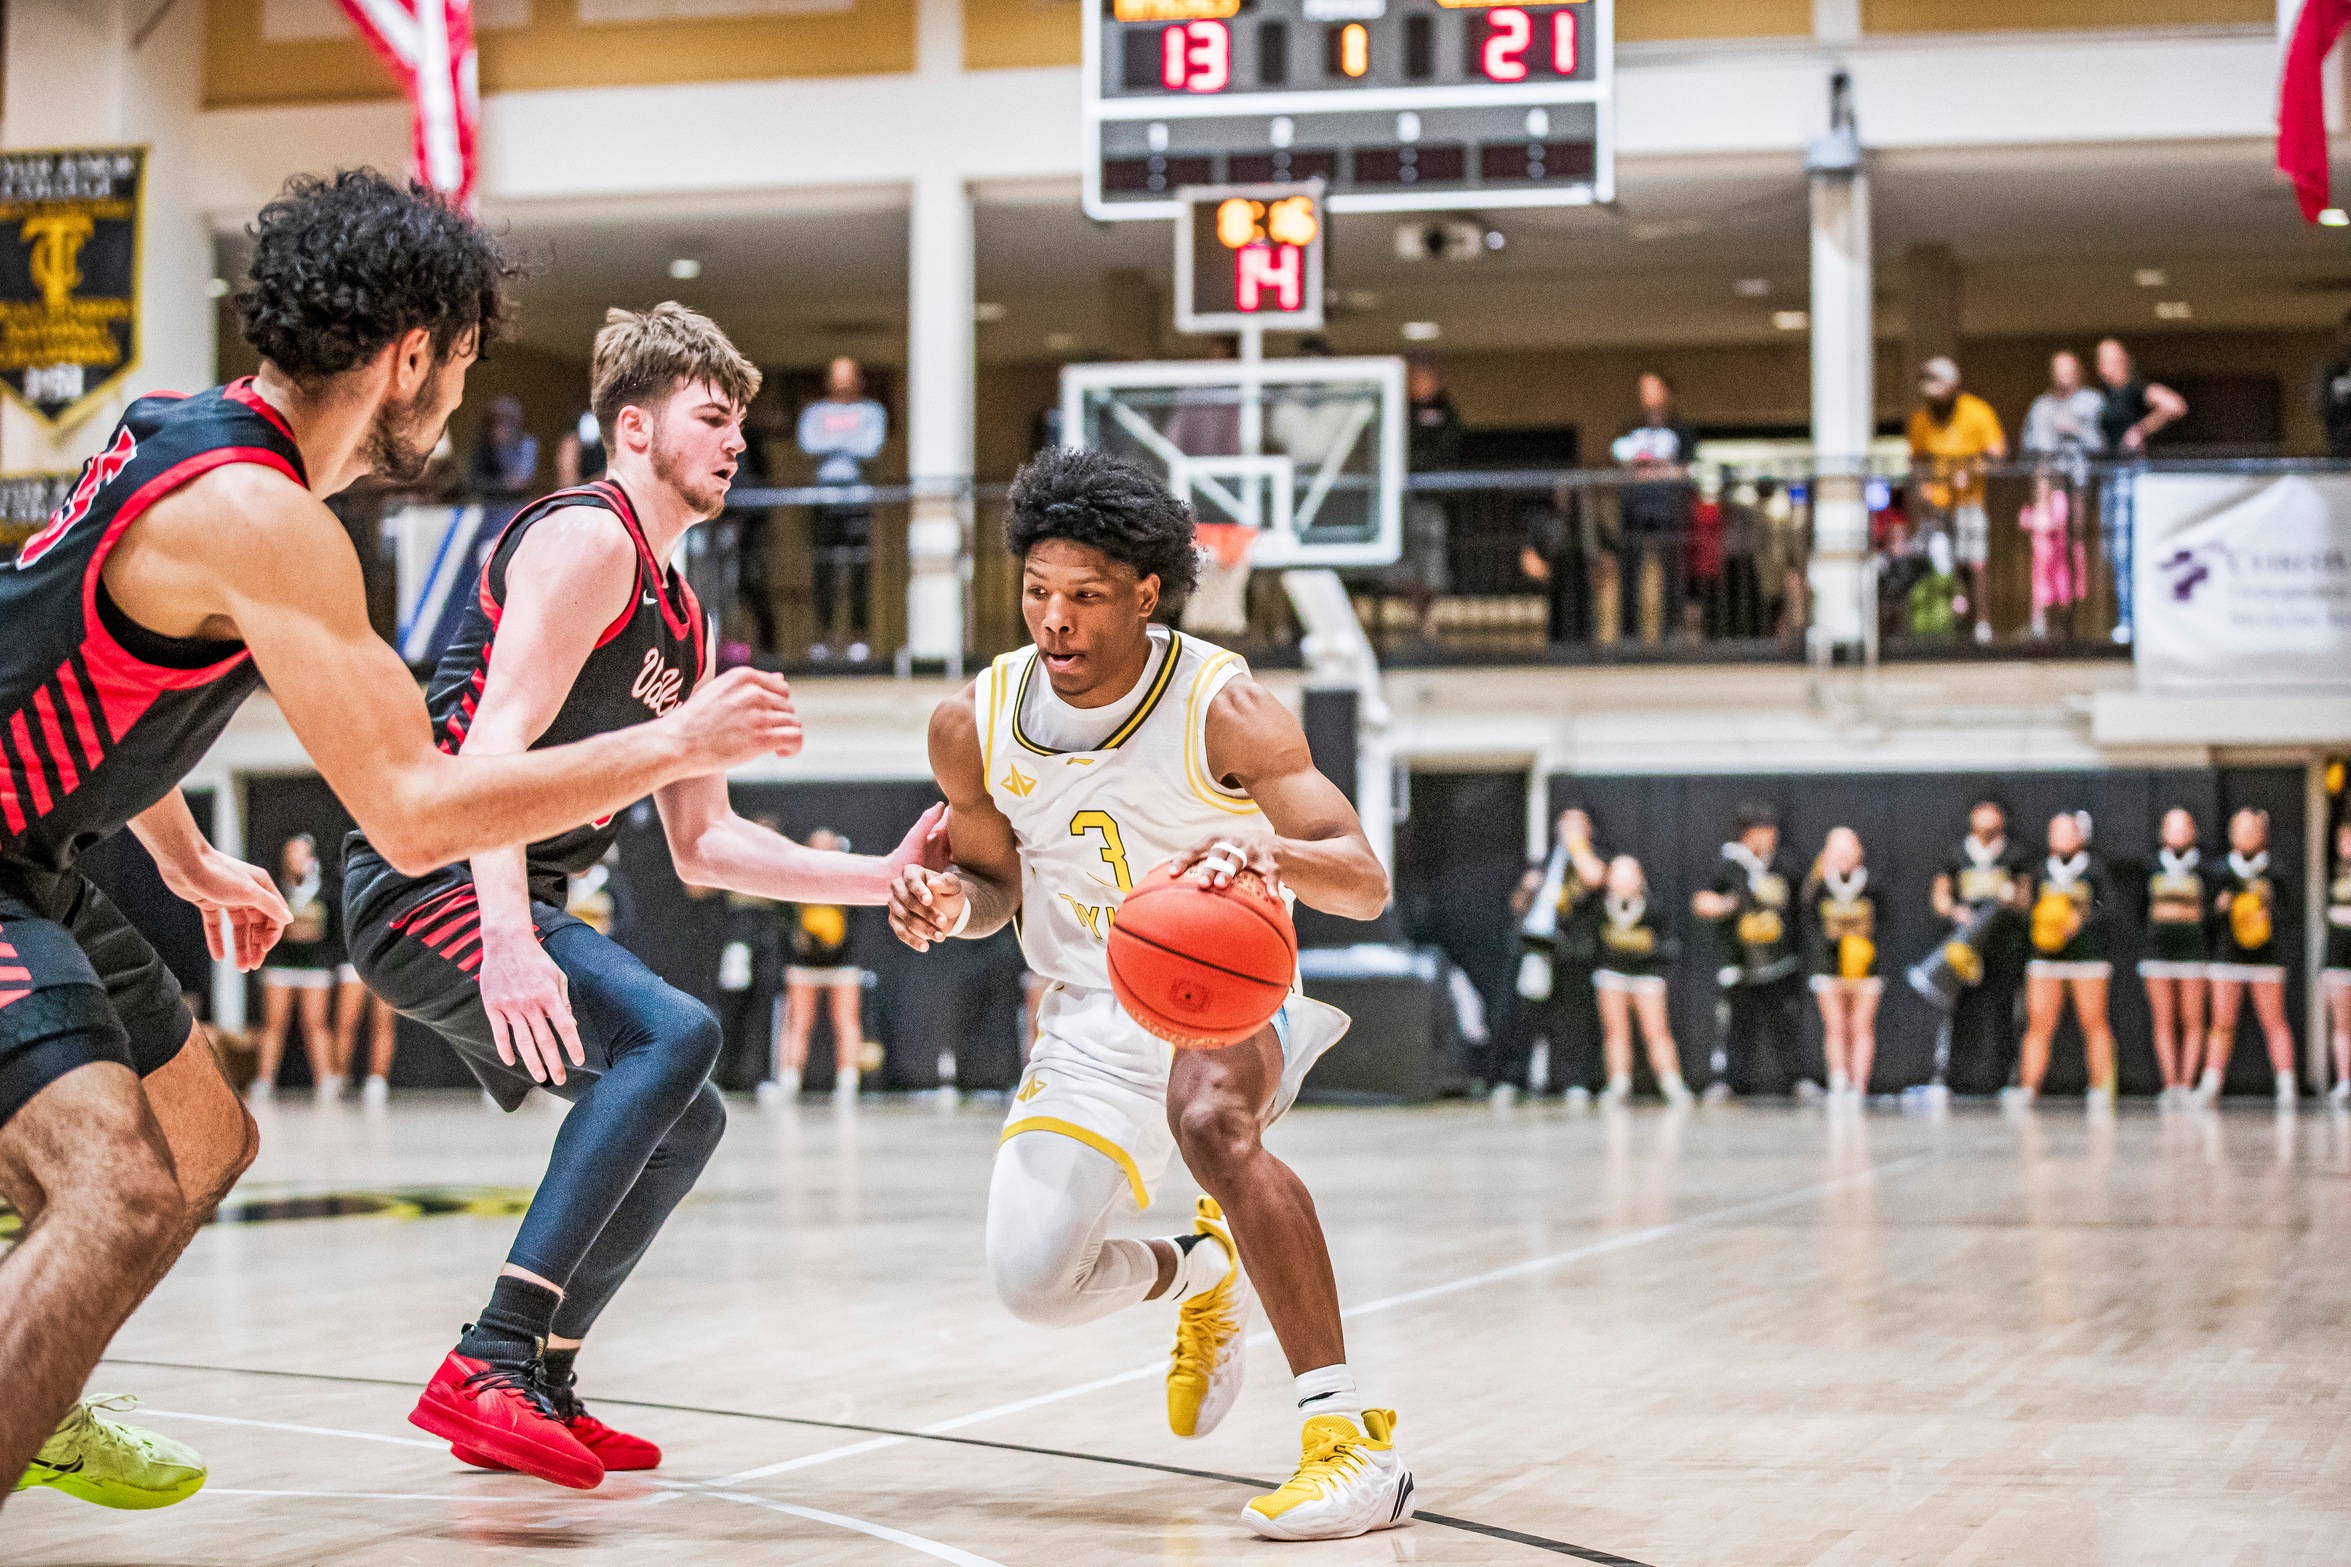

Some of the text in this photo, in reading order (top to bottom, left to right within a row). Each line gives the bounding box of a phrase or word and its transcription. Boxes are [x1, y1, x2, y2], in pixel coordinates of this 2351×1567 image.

[1162, 19, 1230, 92] 13
[1341, 23, 1368, 77] 1
[1481, 8, 1577, 82] 21
[1236, 243, 1302, 313] 14
[1069, 810, 1133, 894] 3
